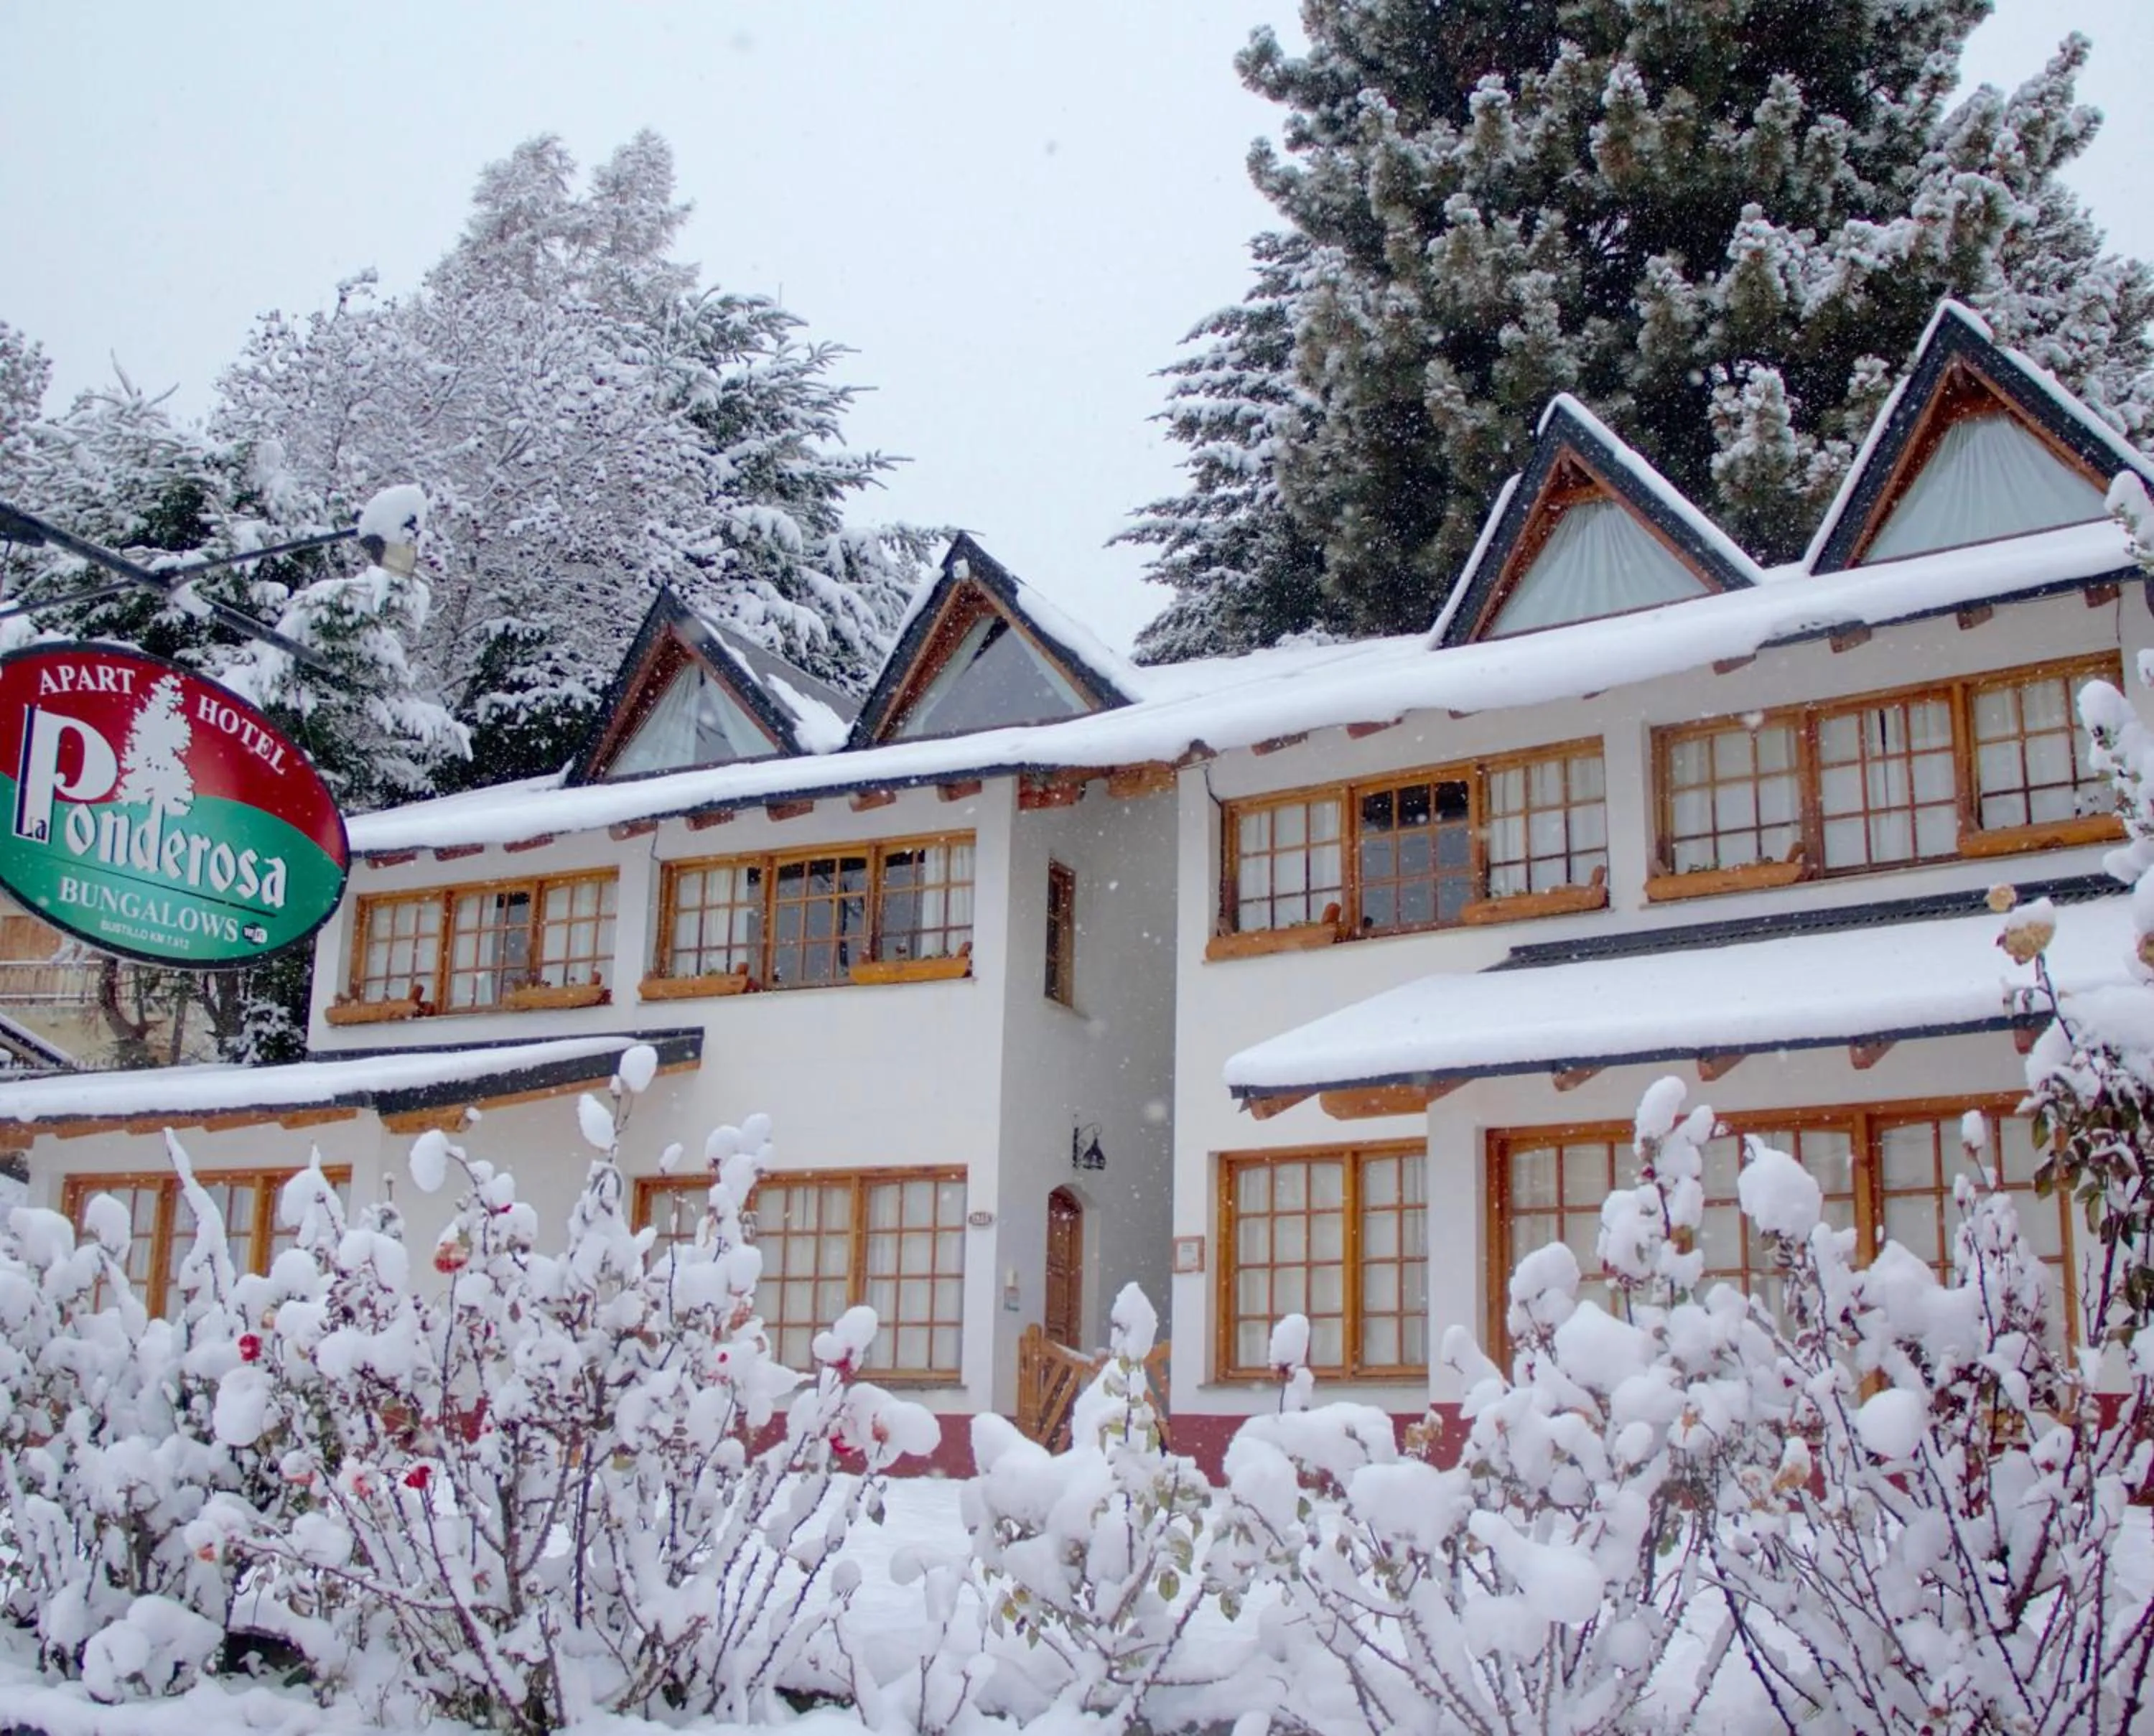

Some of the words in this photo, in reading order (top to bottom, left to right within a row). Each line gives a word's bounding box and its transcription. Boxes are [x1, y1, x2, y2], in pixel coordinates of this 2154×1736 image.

[39, 665, 136, 696] APART
[197, 694, 286, 776] HOTEL
[11, 704, 287, 909] Ponderosa
[59, 876, 239, 943] BUNGALOWS
